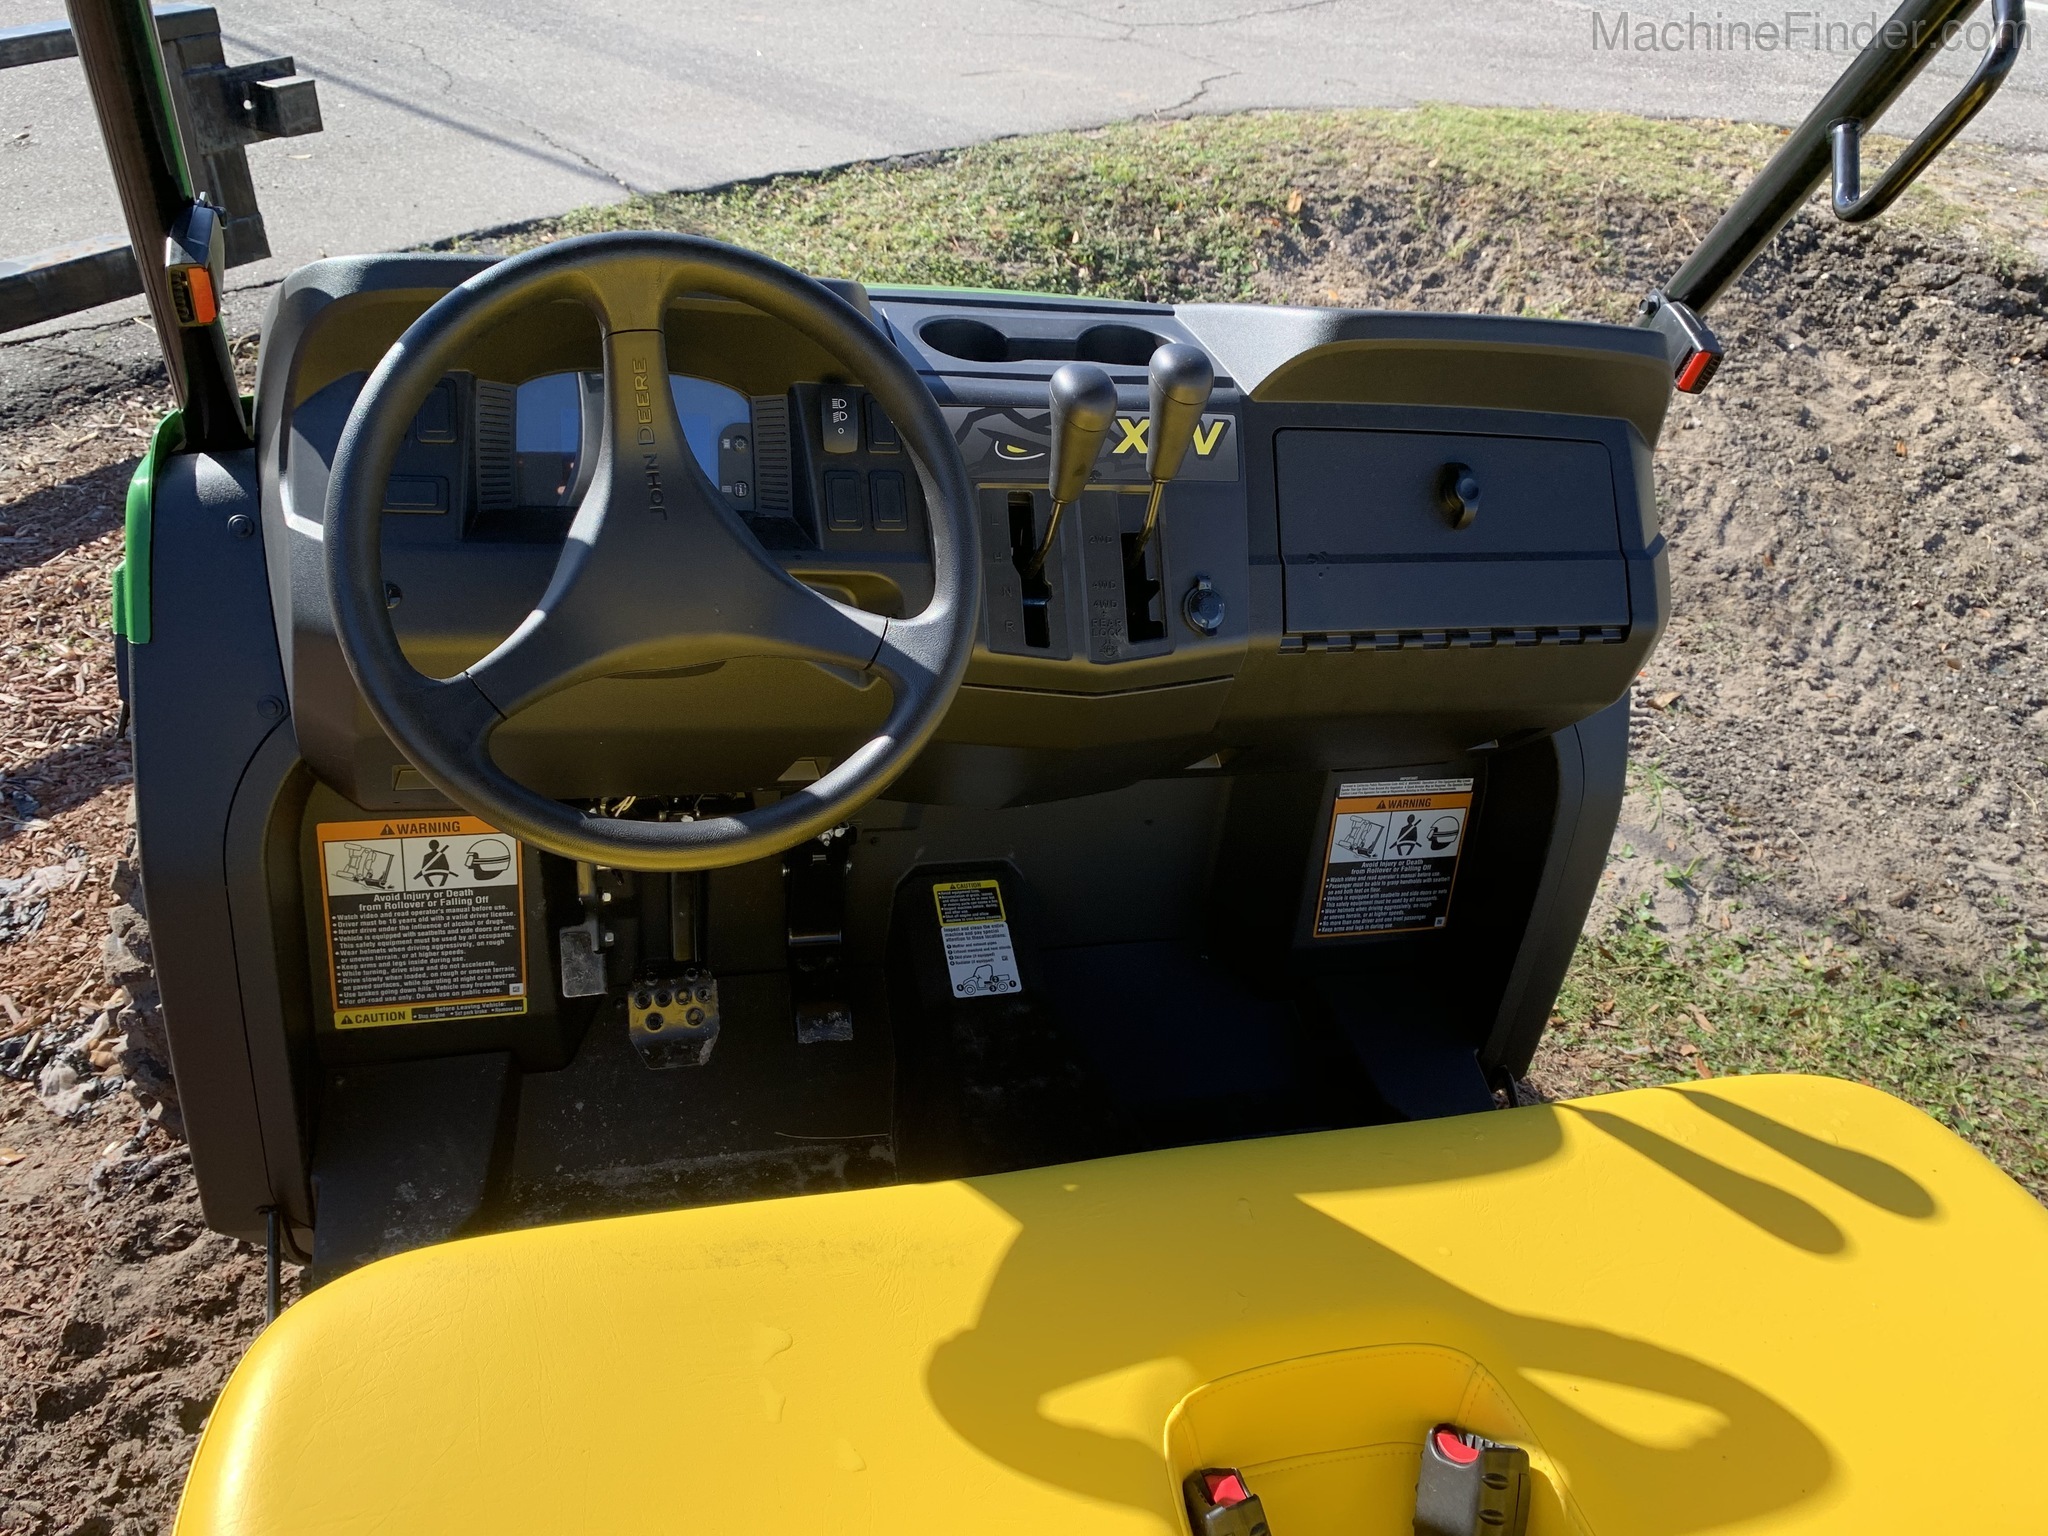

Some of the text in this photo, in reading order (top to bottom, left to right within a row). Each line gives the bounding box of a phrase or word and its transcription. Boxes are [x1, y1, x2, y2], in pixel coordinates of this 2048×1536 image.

[632, 357, 668, 521] JOHN DEERE
[1112, 418, 1226, 456] XV
[1005, 619, 1016, 633] R
[1091, 618, 1123, 629] REAR
[1387, 797, 1432, 809] WARNING
[396, 821, 461, 835] WARNING
[1379, 860, 1397, 868] Injury
[373, 893, 400, 902] Avoid
[403, 892, 431, 902] Injury
[446, 889, 474, 897] Death
[359, 903, 382, 911] from
[384, 900, 425, 909] Rollover
[440, 897, 472, 908] Falling
[476, 896, 489, 904] Off
[410, 908, 444, 917] operator's
[372, 932, 401, 940] equipped
[355, 941, 376, 949] safety
[377, 938, 412, 947] equipment
[406, 944, 430, 952] driving
[418, 950, 441, 958] higher
[341, 963, 358, 971] Keep
[353, 983, 372, 991] paved
[421, 977, 451, 985] operating
[362, 975, 383, 983] slowly
[354, 1010, 406, 1025] CAUTION
